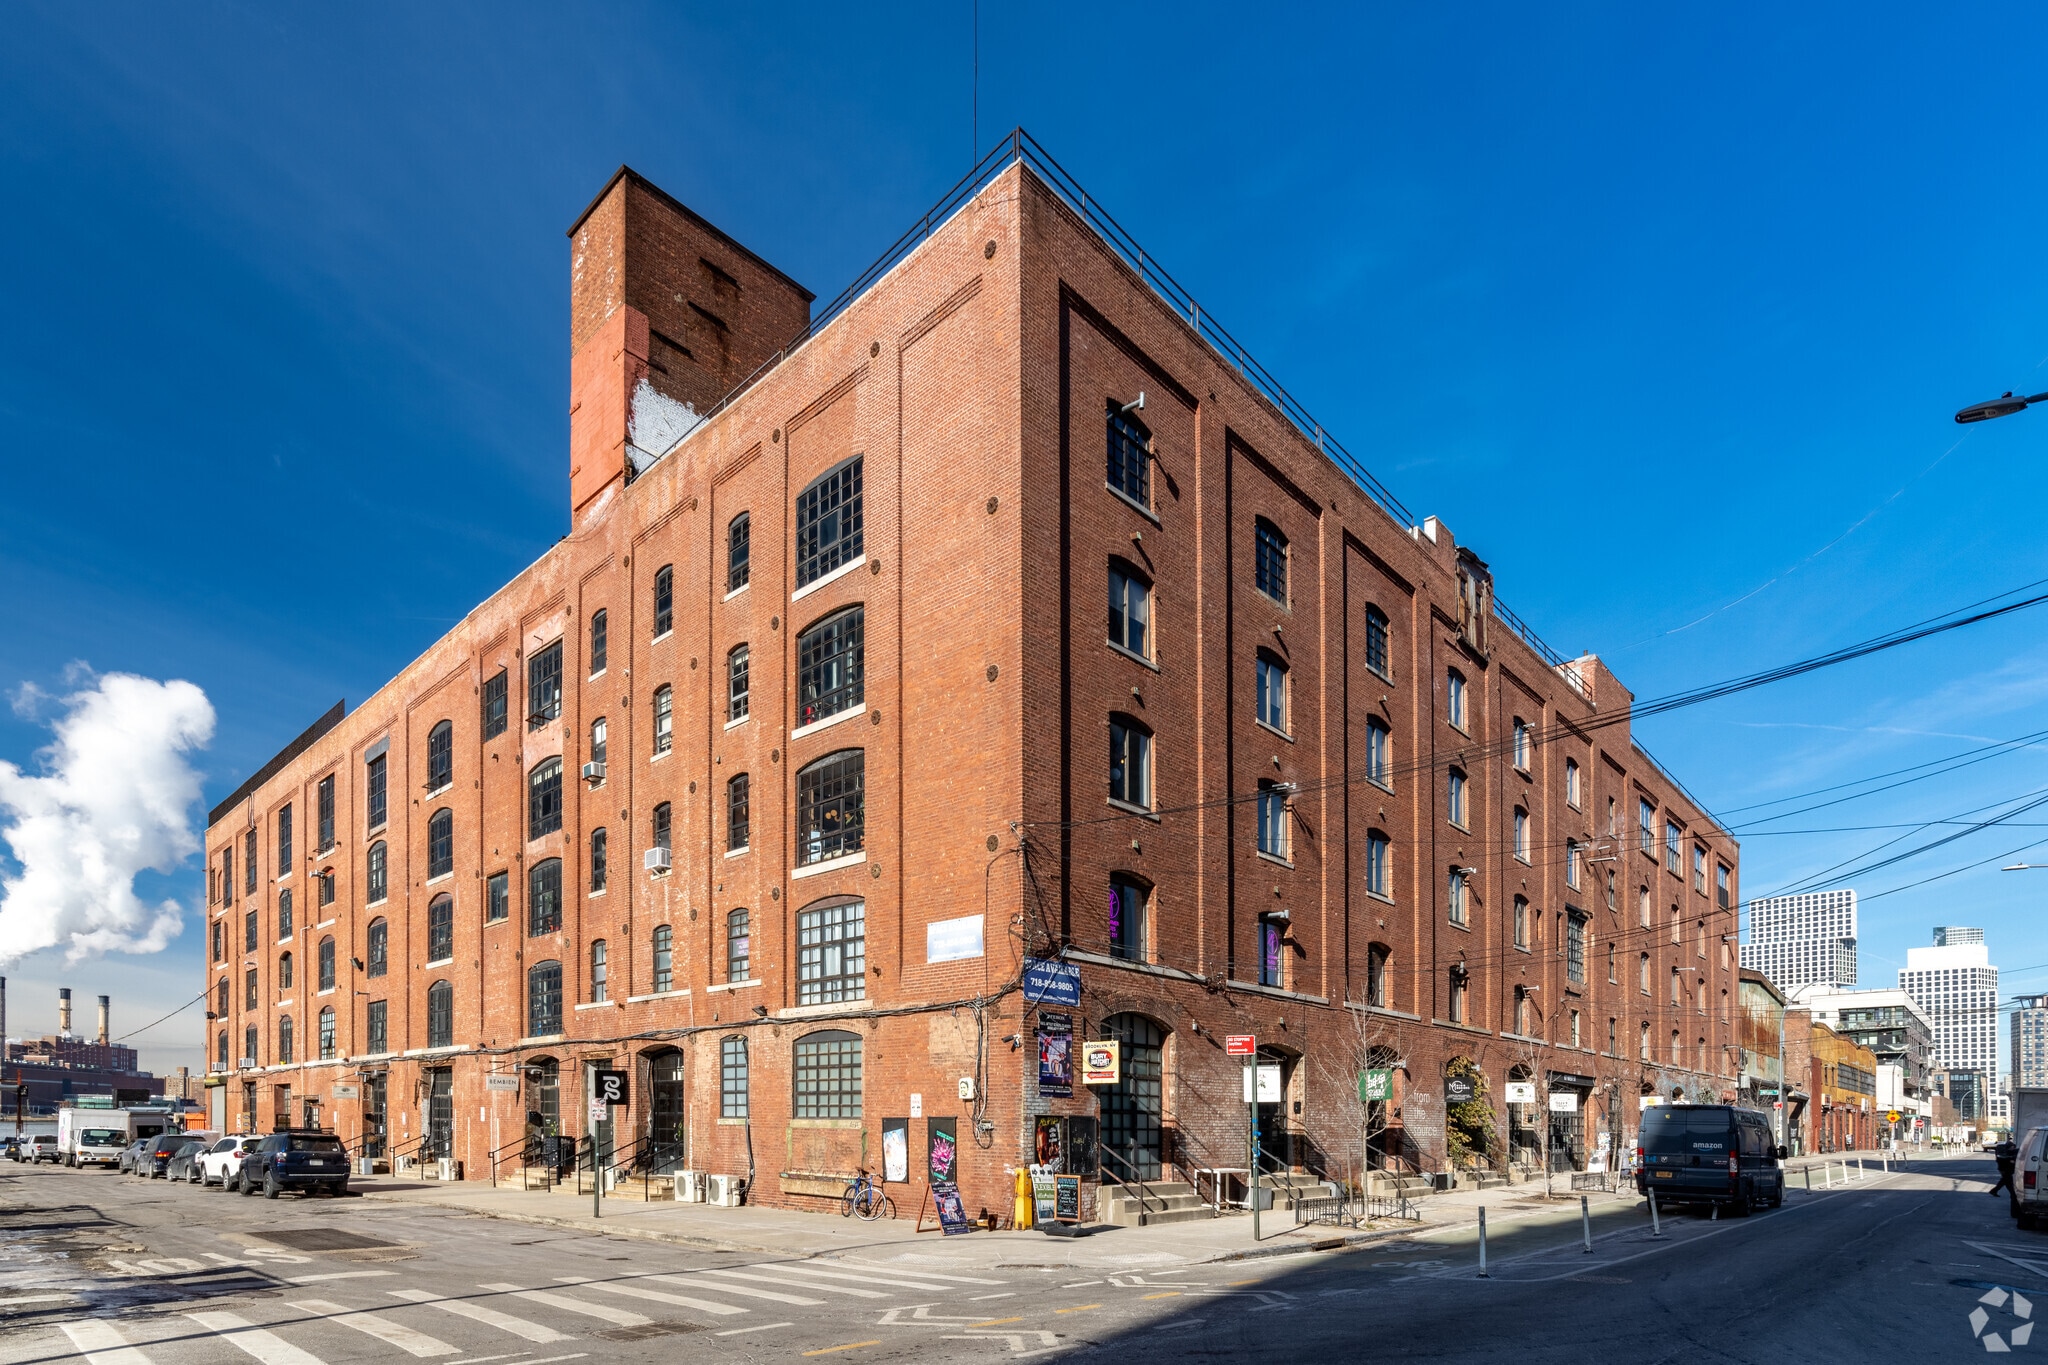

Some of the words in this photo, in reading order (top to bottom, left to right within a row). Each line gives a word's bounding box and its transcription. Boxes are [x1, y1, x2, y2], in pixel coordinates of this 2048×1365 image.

[1413, 1092, 1431, 1103] from
[1413, 1106, 1426, 1120] the
[1413, 1125, 1438, 1137] source
[1692, 1142, 1723, 1150] amazon
